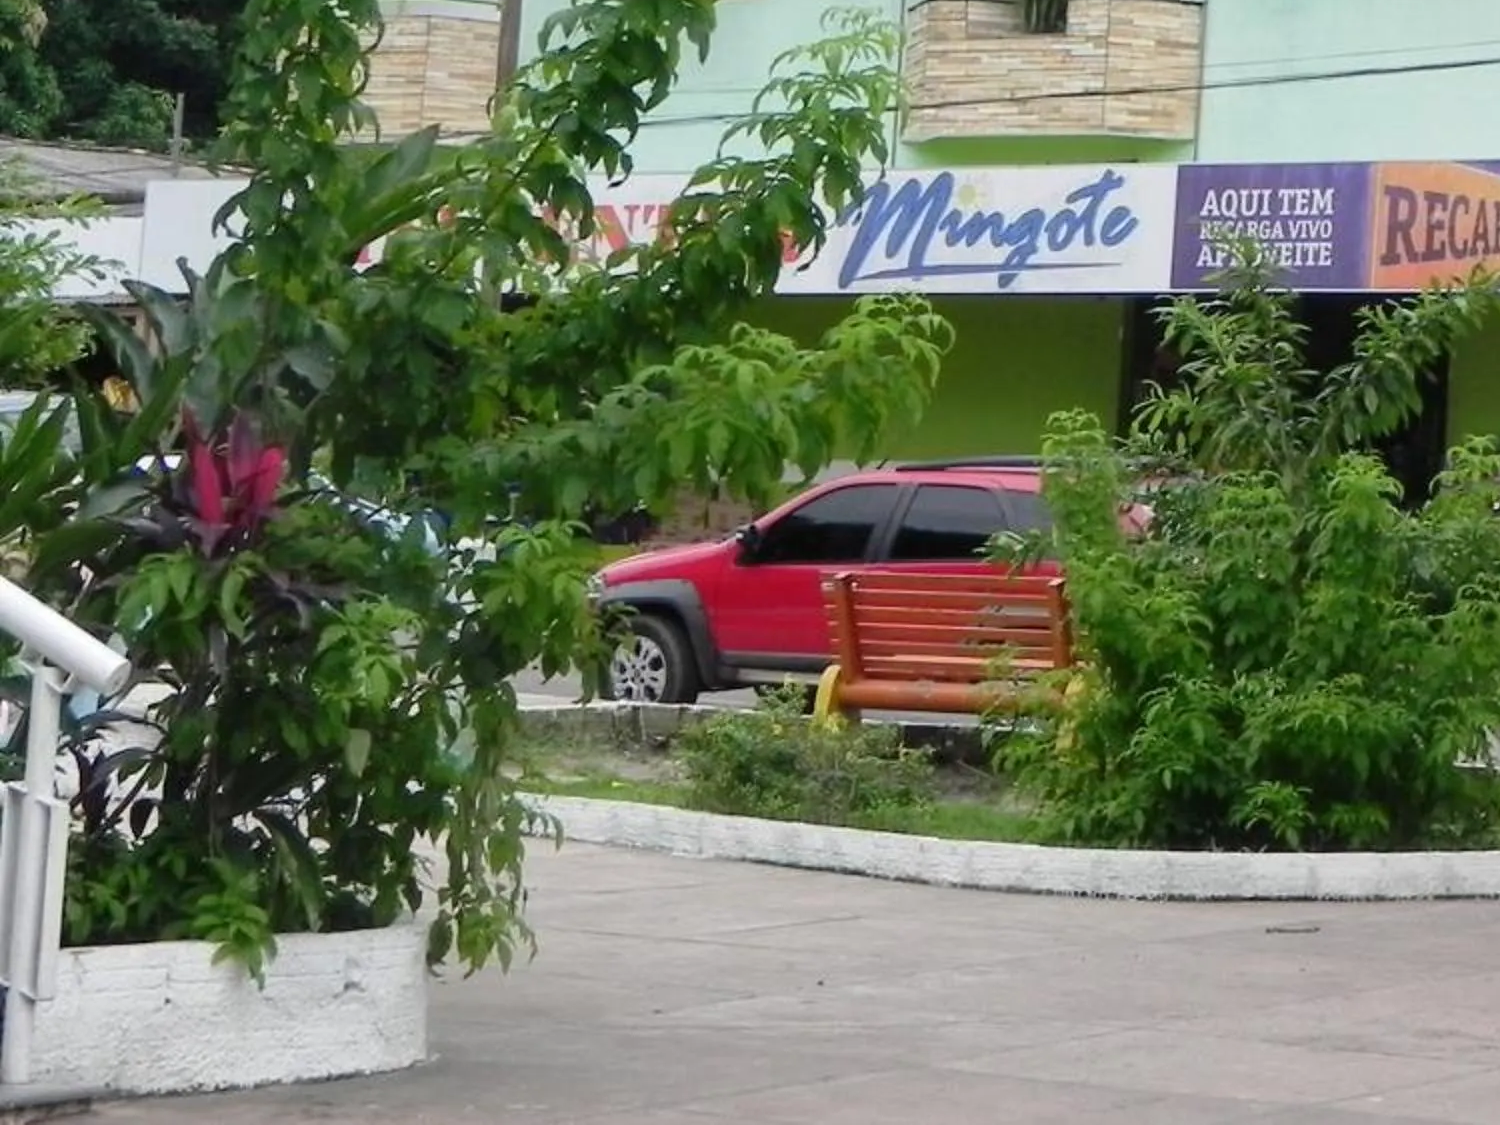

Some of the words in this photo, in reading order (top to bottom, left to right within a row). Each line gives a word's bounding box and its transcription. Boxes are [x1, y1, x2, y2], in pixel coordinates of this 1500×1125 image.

[1200, 188, 1273, 218] AQUI
[1278, 188, 1335, 216] TEM
[1288, 219, 1333, 240] VIVO
